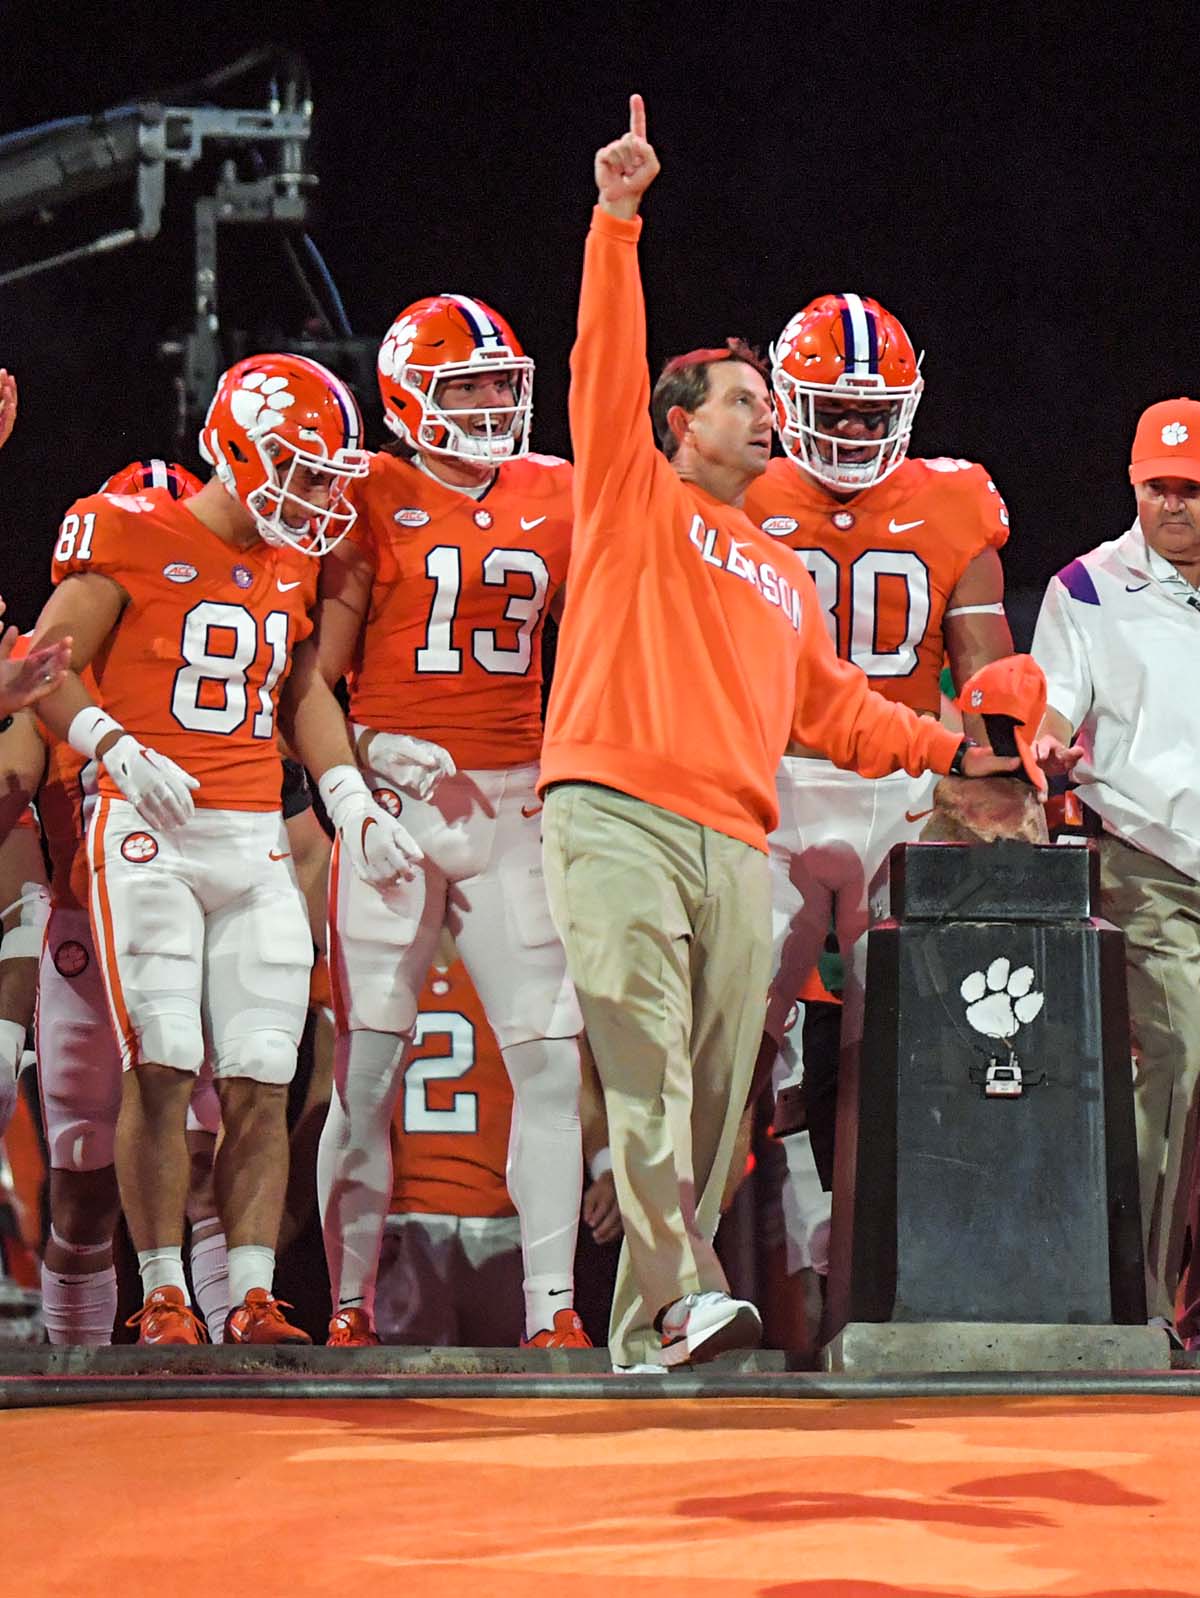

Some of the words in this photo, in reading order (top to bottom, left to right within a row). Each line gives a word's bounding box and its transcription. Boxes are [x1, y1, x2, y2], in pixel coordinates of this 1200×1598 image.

[55, 512, 96, 562] 81
[170, 600, 289, 740] 81
[415, 545, 550, 677] 13
[402, 1010, 479, 1134] 2
